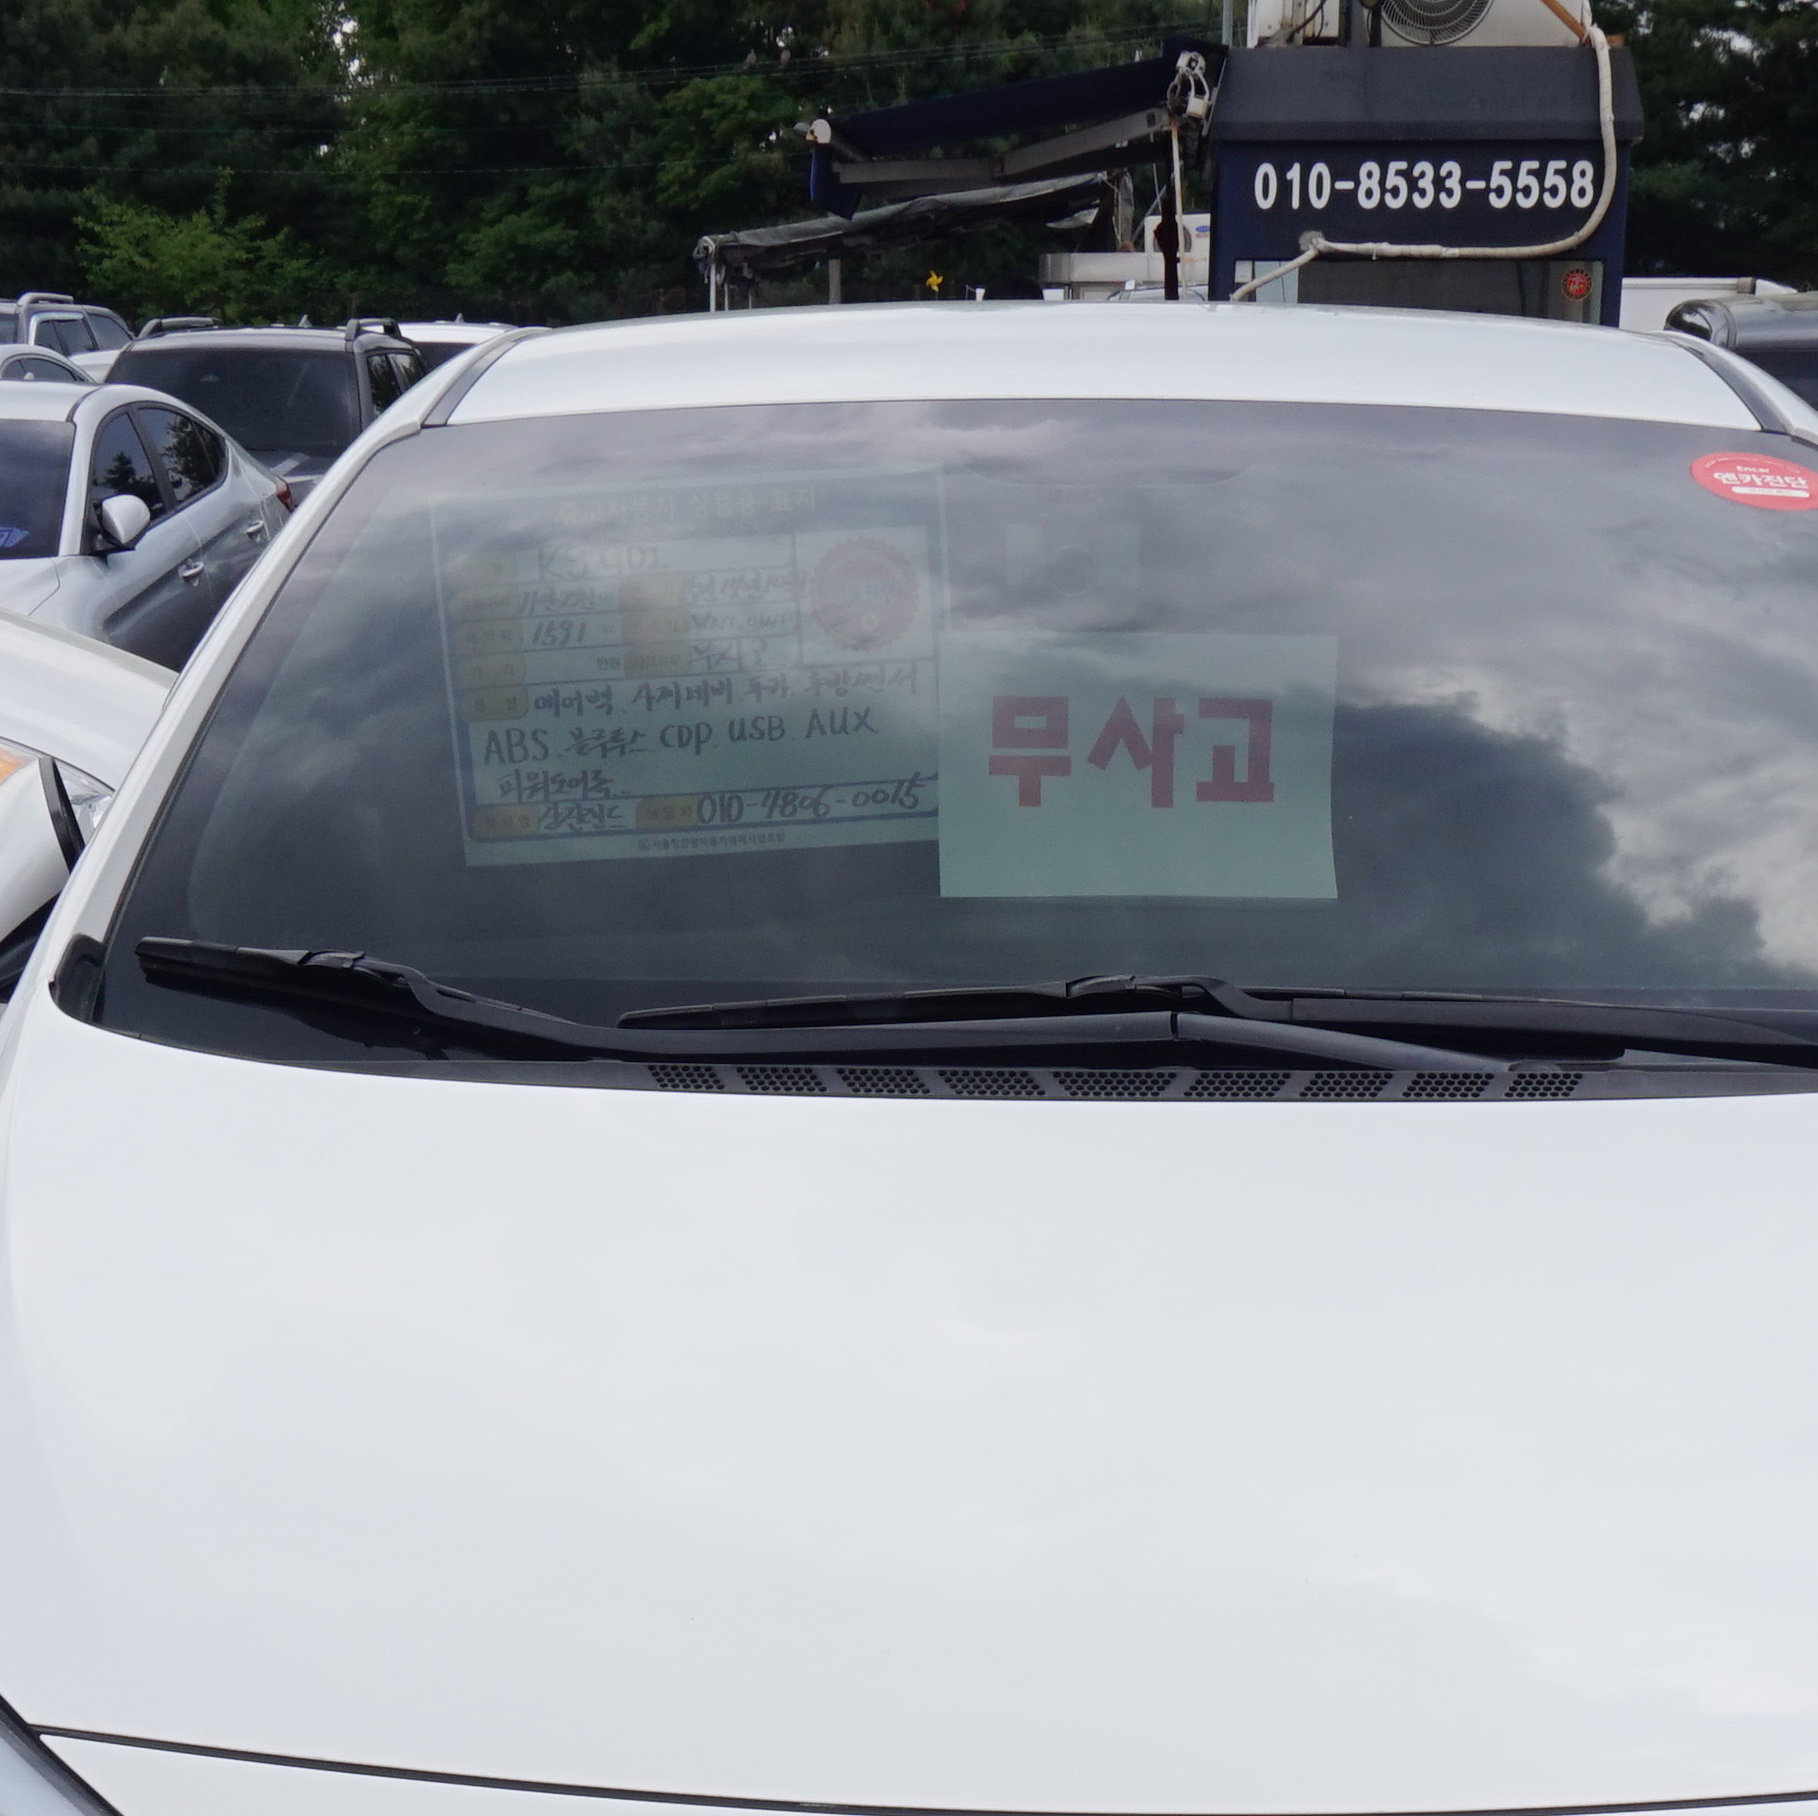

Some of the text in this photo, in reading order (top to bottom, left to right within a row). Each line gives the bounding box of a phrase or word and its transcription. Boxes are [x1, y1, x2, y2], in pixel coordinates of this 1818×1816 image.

[1253, 159, 1595, 211] 010-8533-5558
[1712, 471, 1811, 489] 엔카진단
[804, 705, 879, 740] AUX
[988, 694, 1275, 809] 무사고
